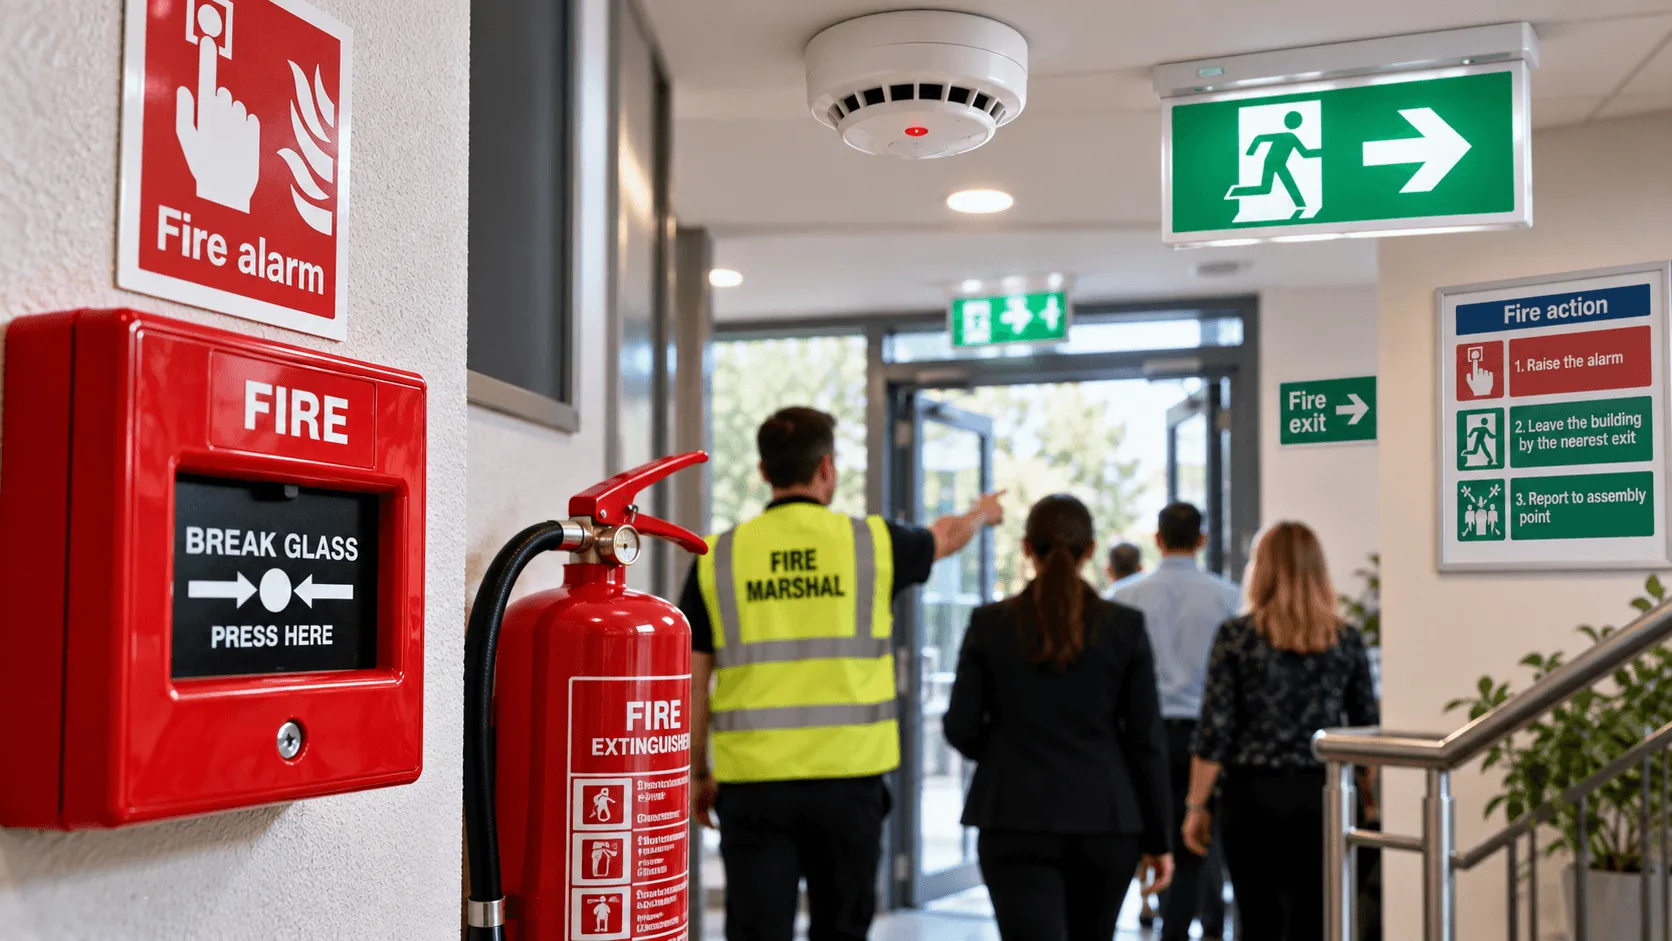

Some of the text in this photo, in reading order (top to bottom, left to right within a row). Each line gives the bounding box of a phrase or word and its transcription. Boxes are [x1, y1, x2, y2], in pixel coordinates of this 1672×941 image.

[157, 204, 325, 295] Fire alarm
[1504, 296, 1609, 325] Fire action
[1514, 352, 1624, 373] 1. Raise the alarm
[244, 379, 349, 445] FIRE
[1289, 390, 1327, 411] Fire
[1289, 412, 1327, 434] exit
[1514, 412, 1642, 434] 2. Leave the building
[1519, 430, 1637, 454] by the nearest exit
[1515, 487, 1647, 508] 3. Report to assembly
[1519, 510, 1552, 527] point
[185, 526, 359, 562] BREAK GLASS
[770, 548, 818, 574] FIRE
[746, 575, 845, 603] MARSHAL
[211, 625, 334, 649] PRESS HERE
[626, 699, 681, 731] FIRE
